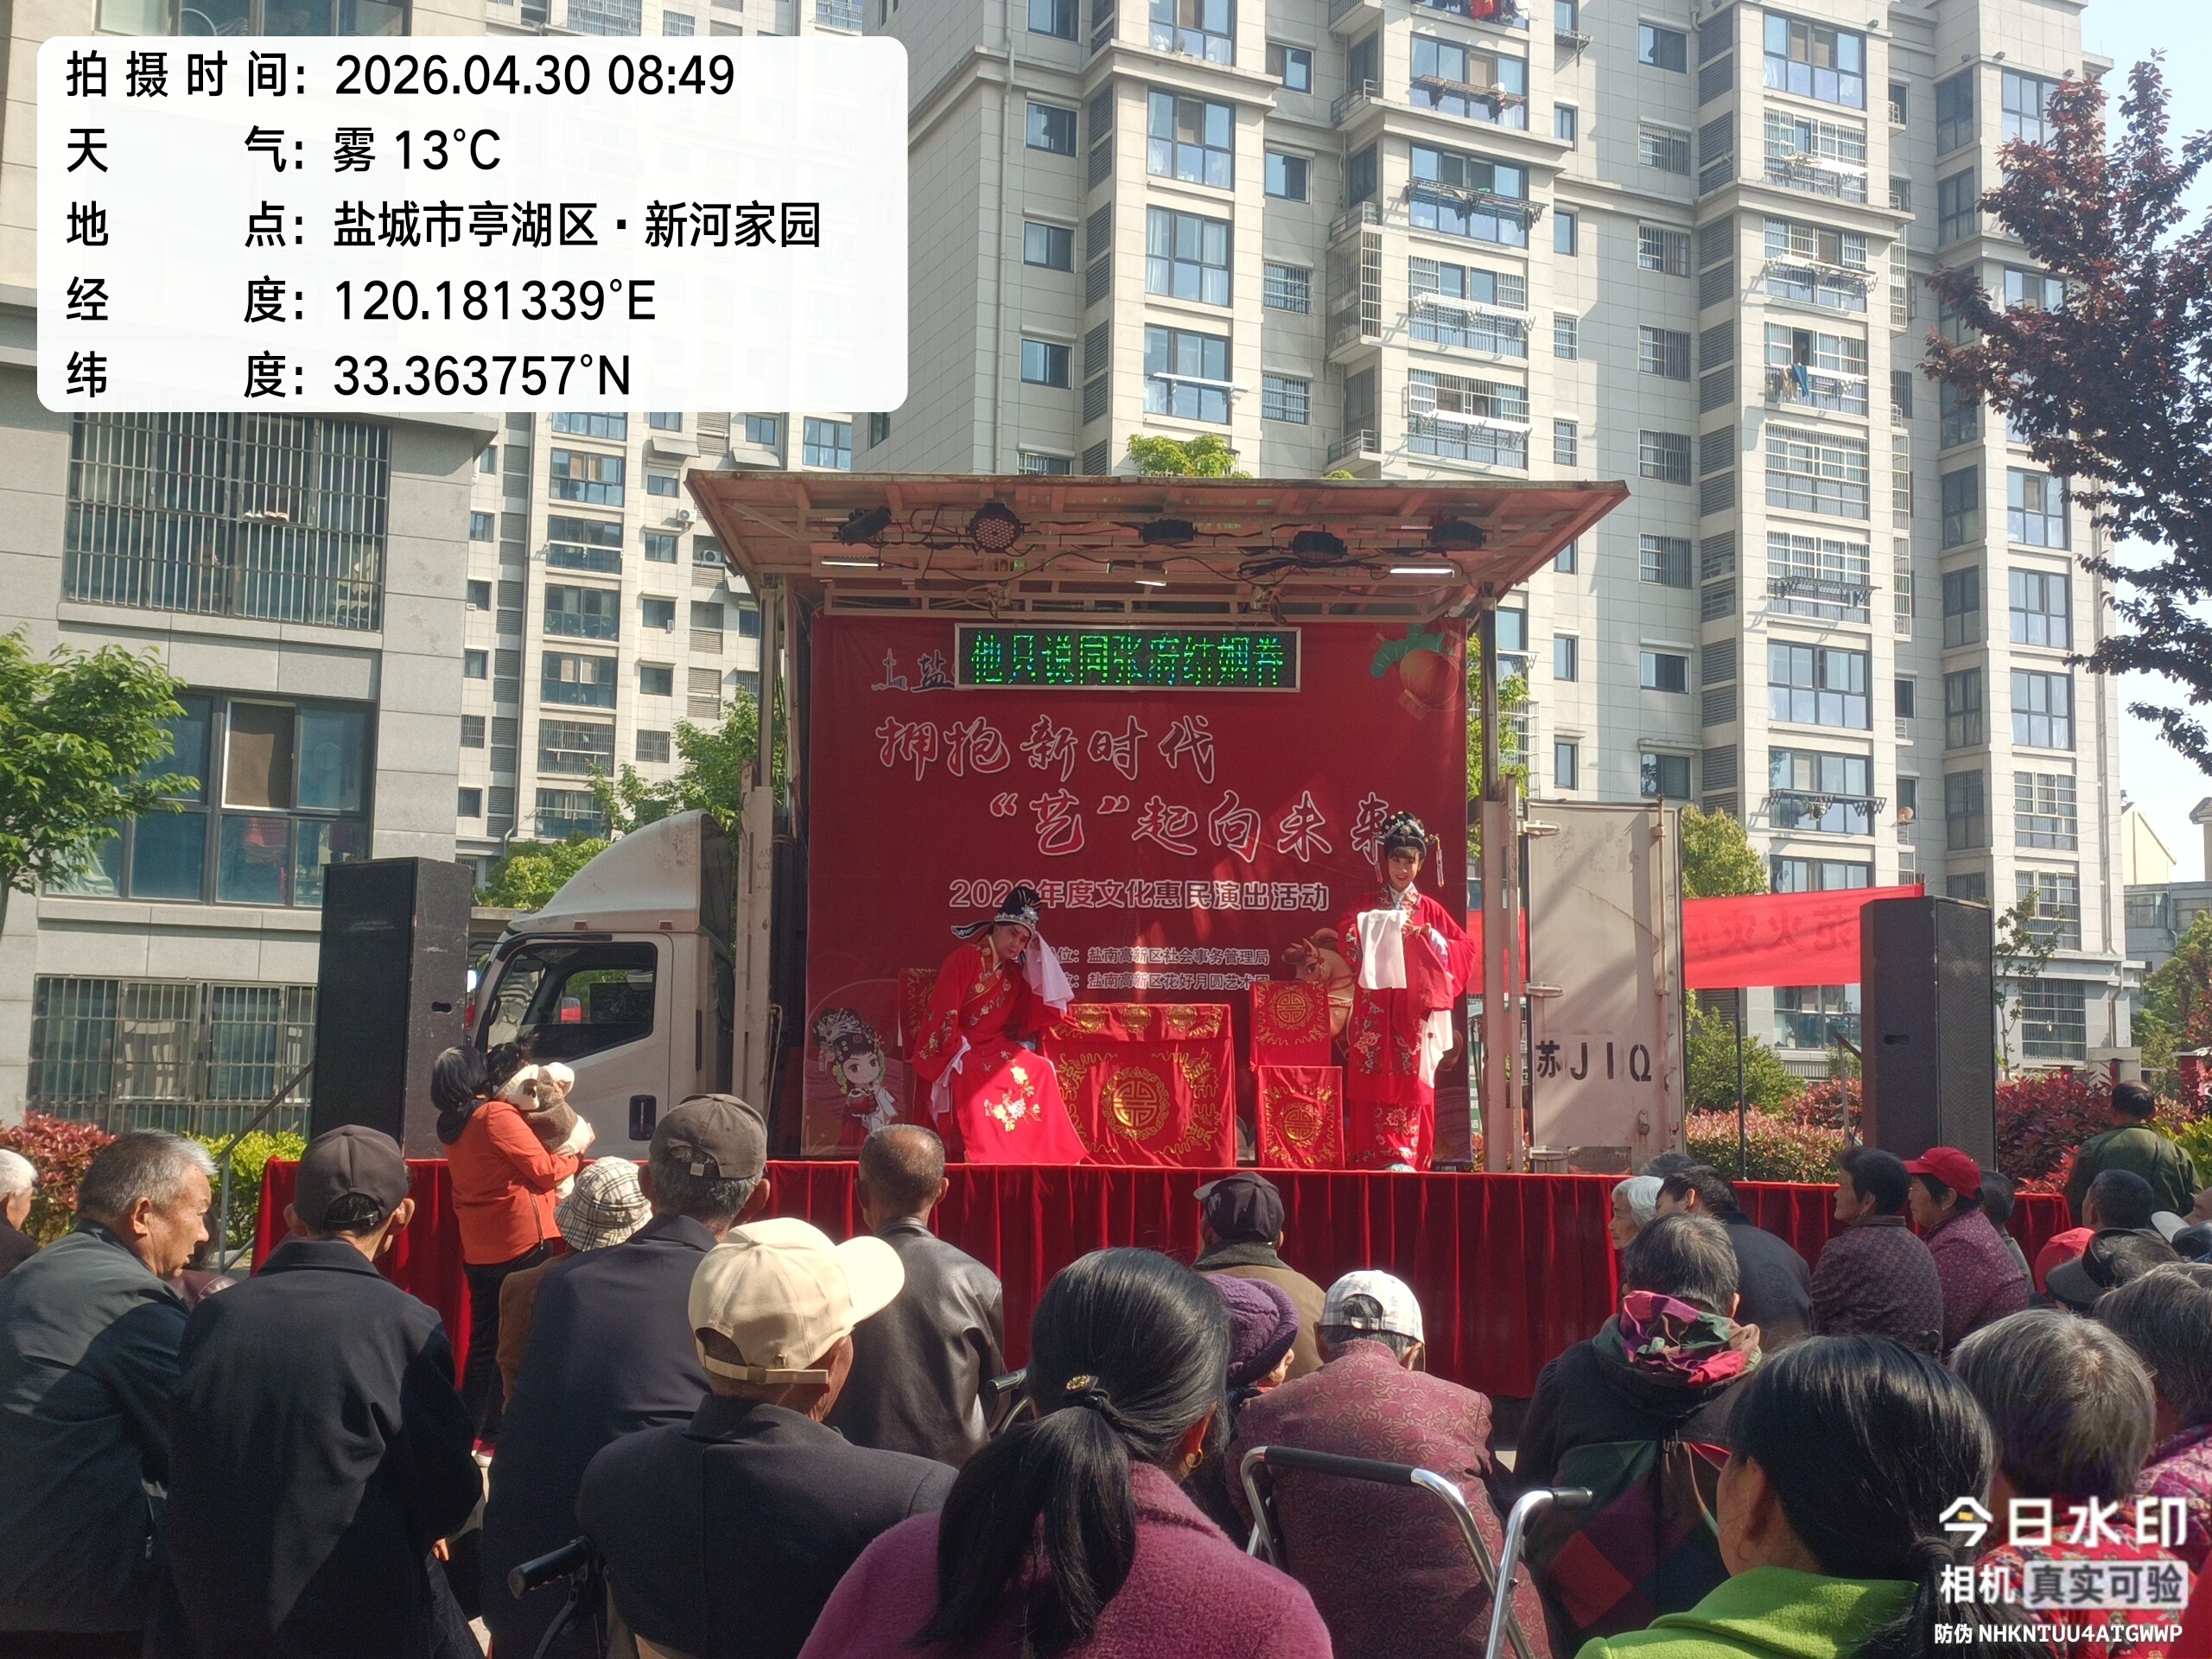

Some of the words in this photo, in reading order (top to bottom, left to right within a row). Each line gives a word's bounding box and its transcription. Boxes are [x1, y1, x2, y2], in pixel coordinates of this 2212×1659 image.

[875, 714, 1214, 784] 拥抱新时代
[950, 878, 1330, 912] 202年度文化惠民演出活动
